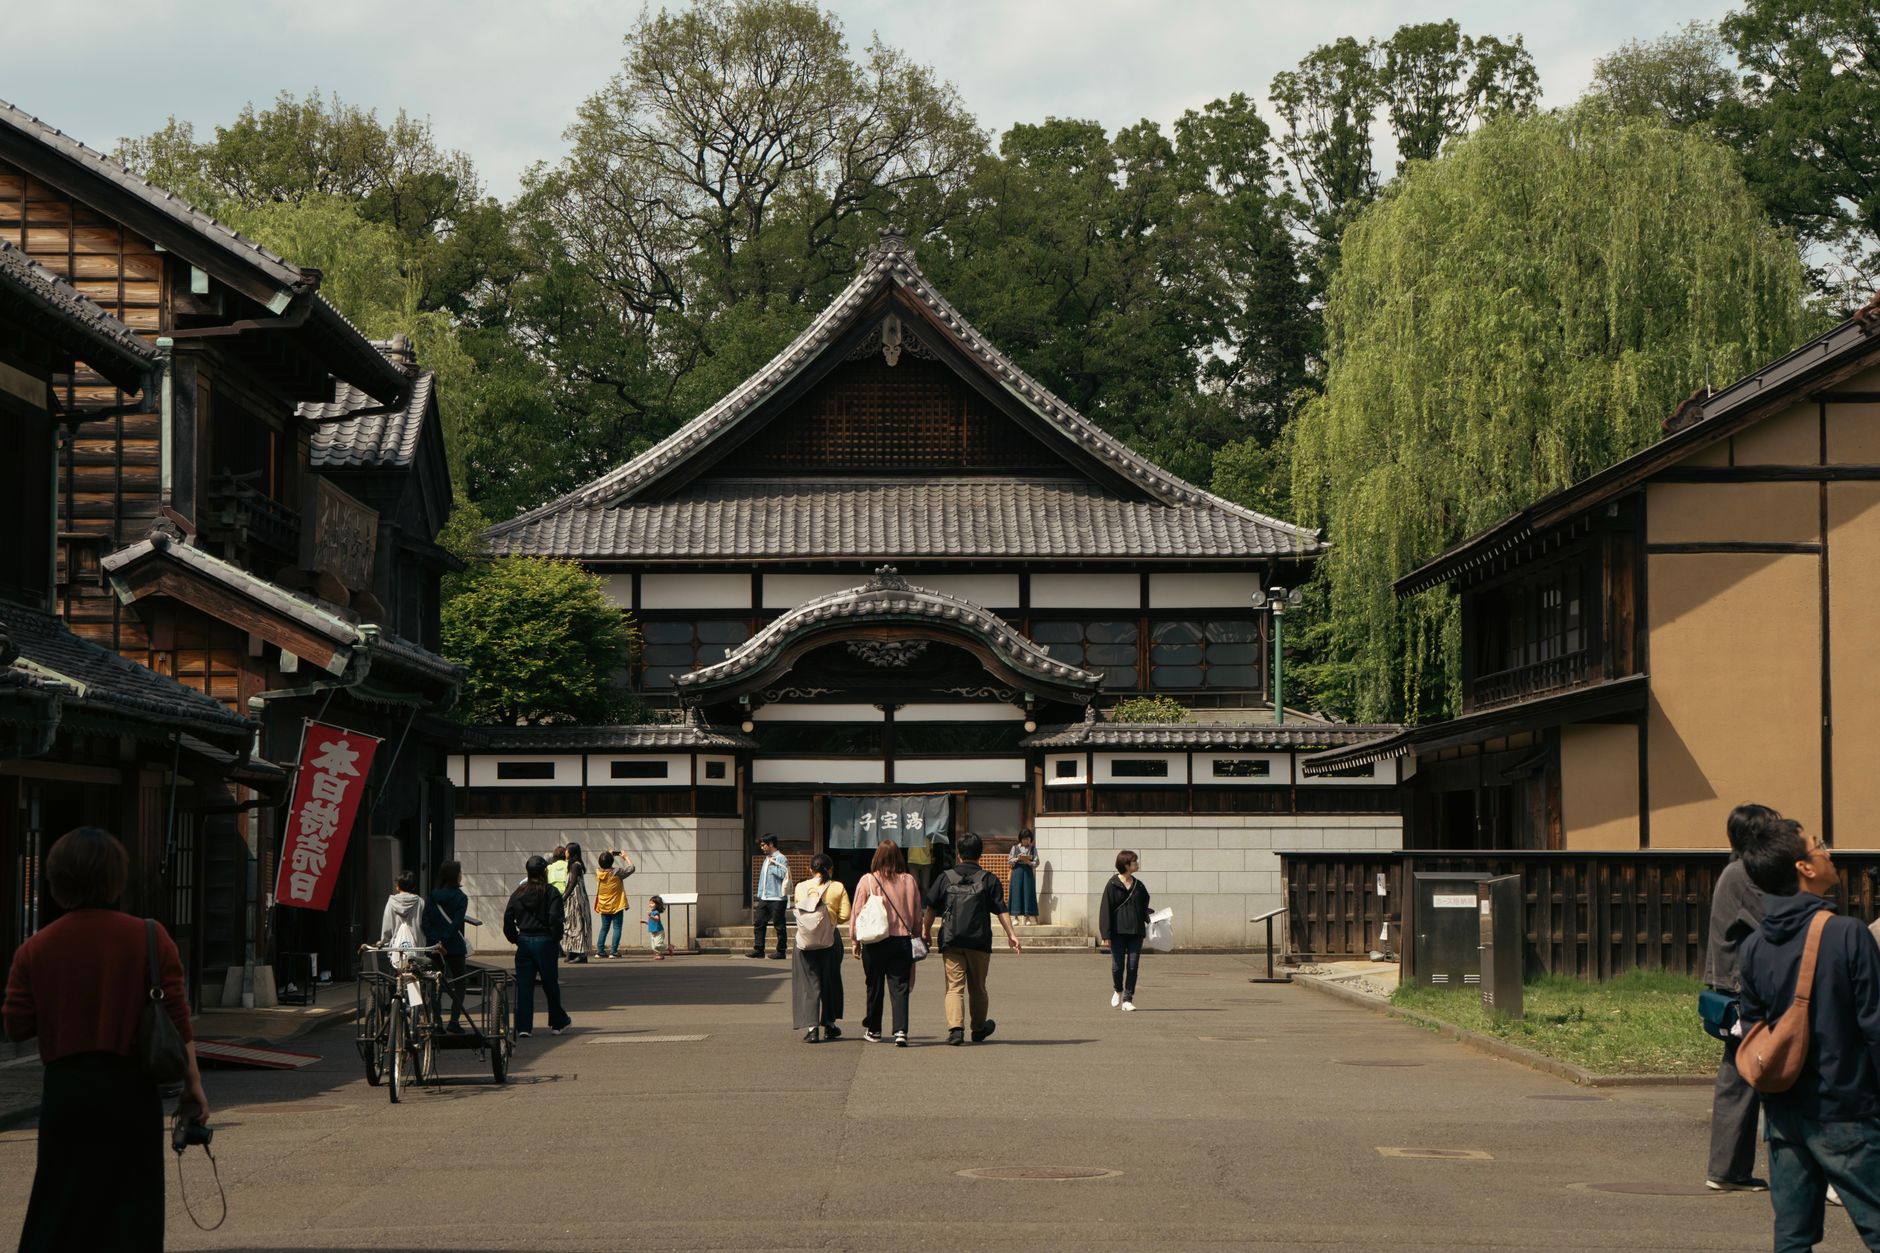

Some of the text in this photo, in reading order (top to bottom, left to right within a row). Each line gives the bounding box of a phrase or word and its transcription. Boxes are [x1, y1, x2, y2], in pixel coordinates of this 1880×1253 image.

[290, 740, 360, 902] 本日特売日
[860, 811, 923, 831] 子宝湯
